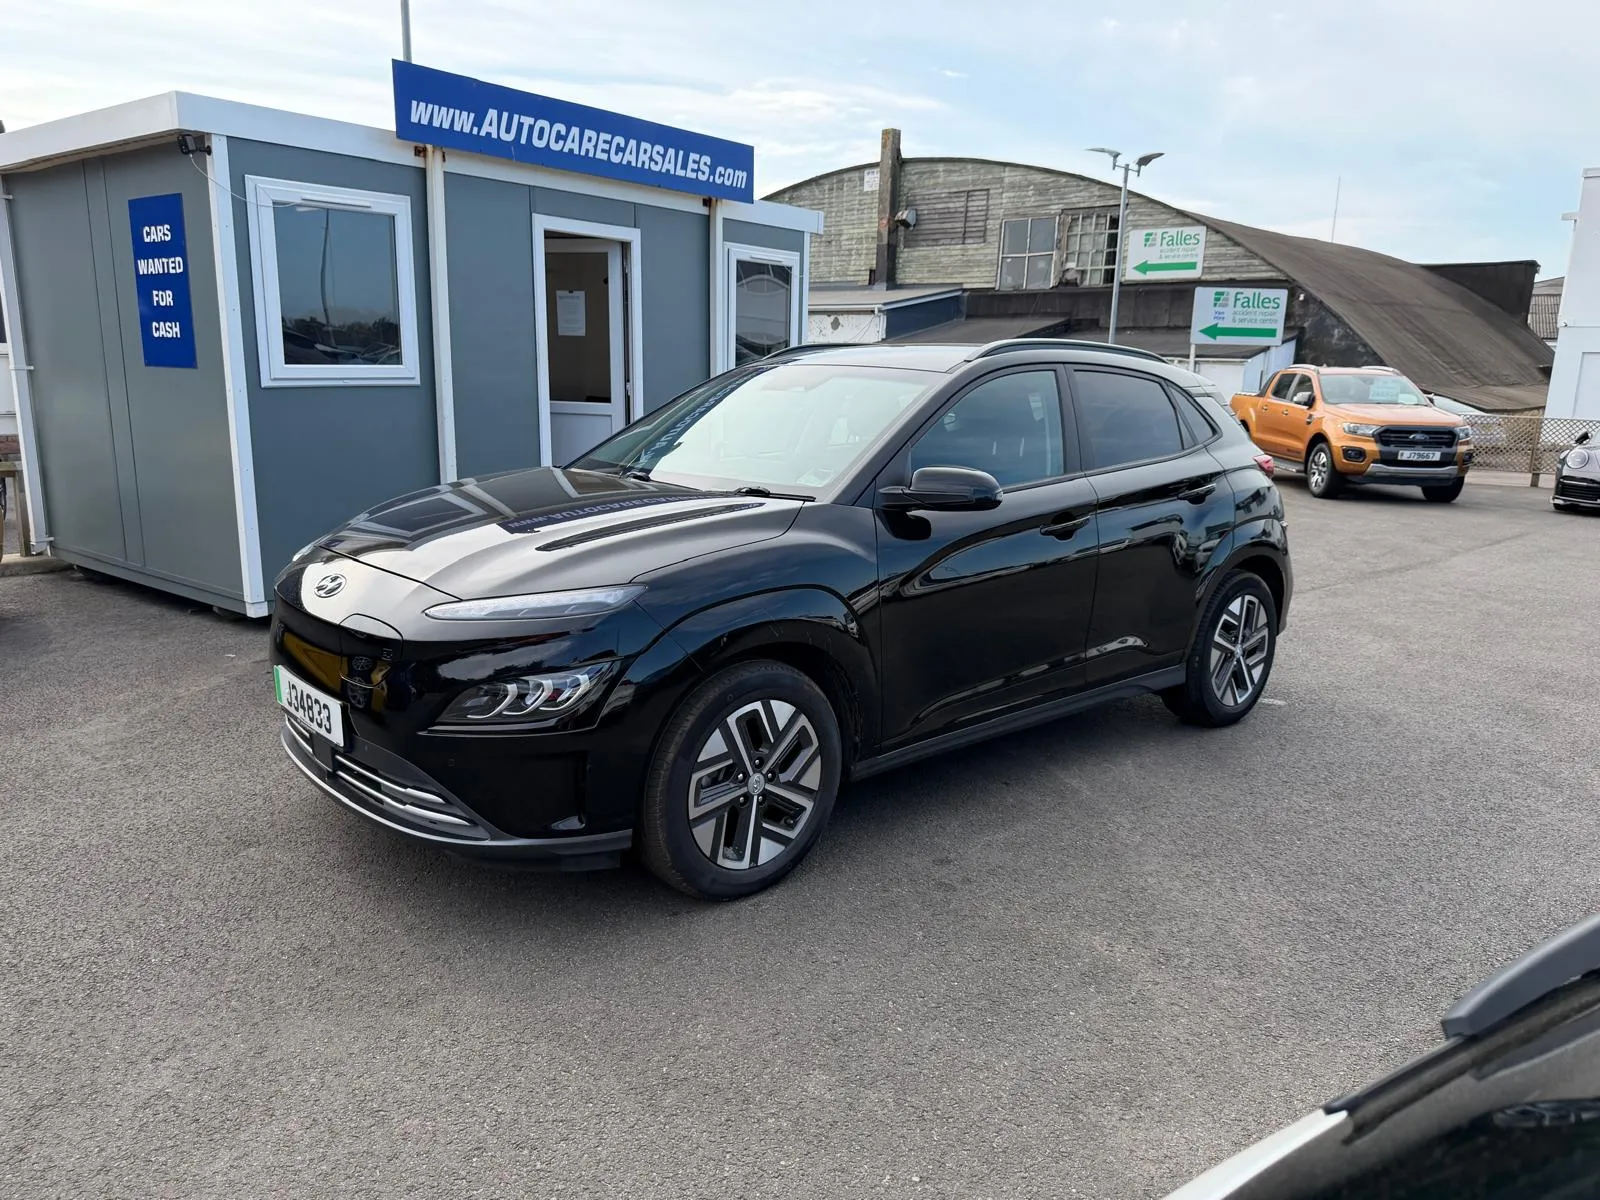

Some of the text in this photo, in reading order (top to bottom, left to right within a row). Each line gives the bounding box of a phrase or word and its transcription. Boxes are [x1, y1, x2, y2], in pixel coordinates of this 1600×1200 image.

[410, 100, 748, 189] www.AUTOCARECARSALES.com
[143, 224, 171, 242] CARS
[1160, 230, 1200, 246] Falles
[138, 256, 183, 275] WANTED
[152, 290, 173, 306] FOR
[1233, 291, 1281, 309] Falles
[152, 322, 180, 338] CASH
[1407, 452, 1436, 460] J79667
[287, 680, 332, 735] J34833
